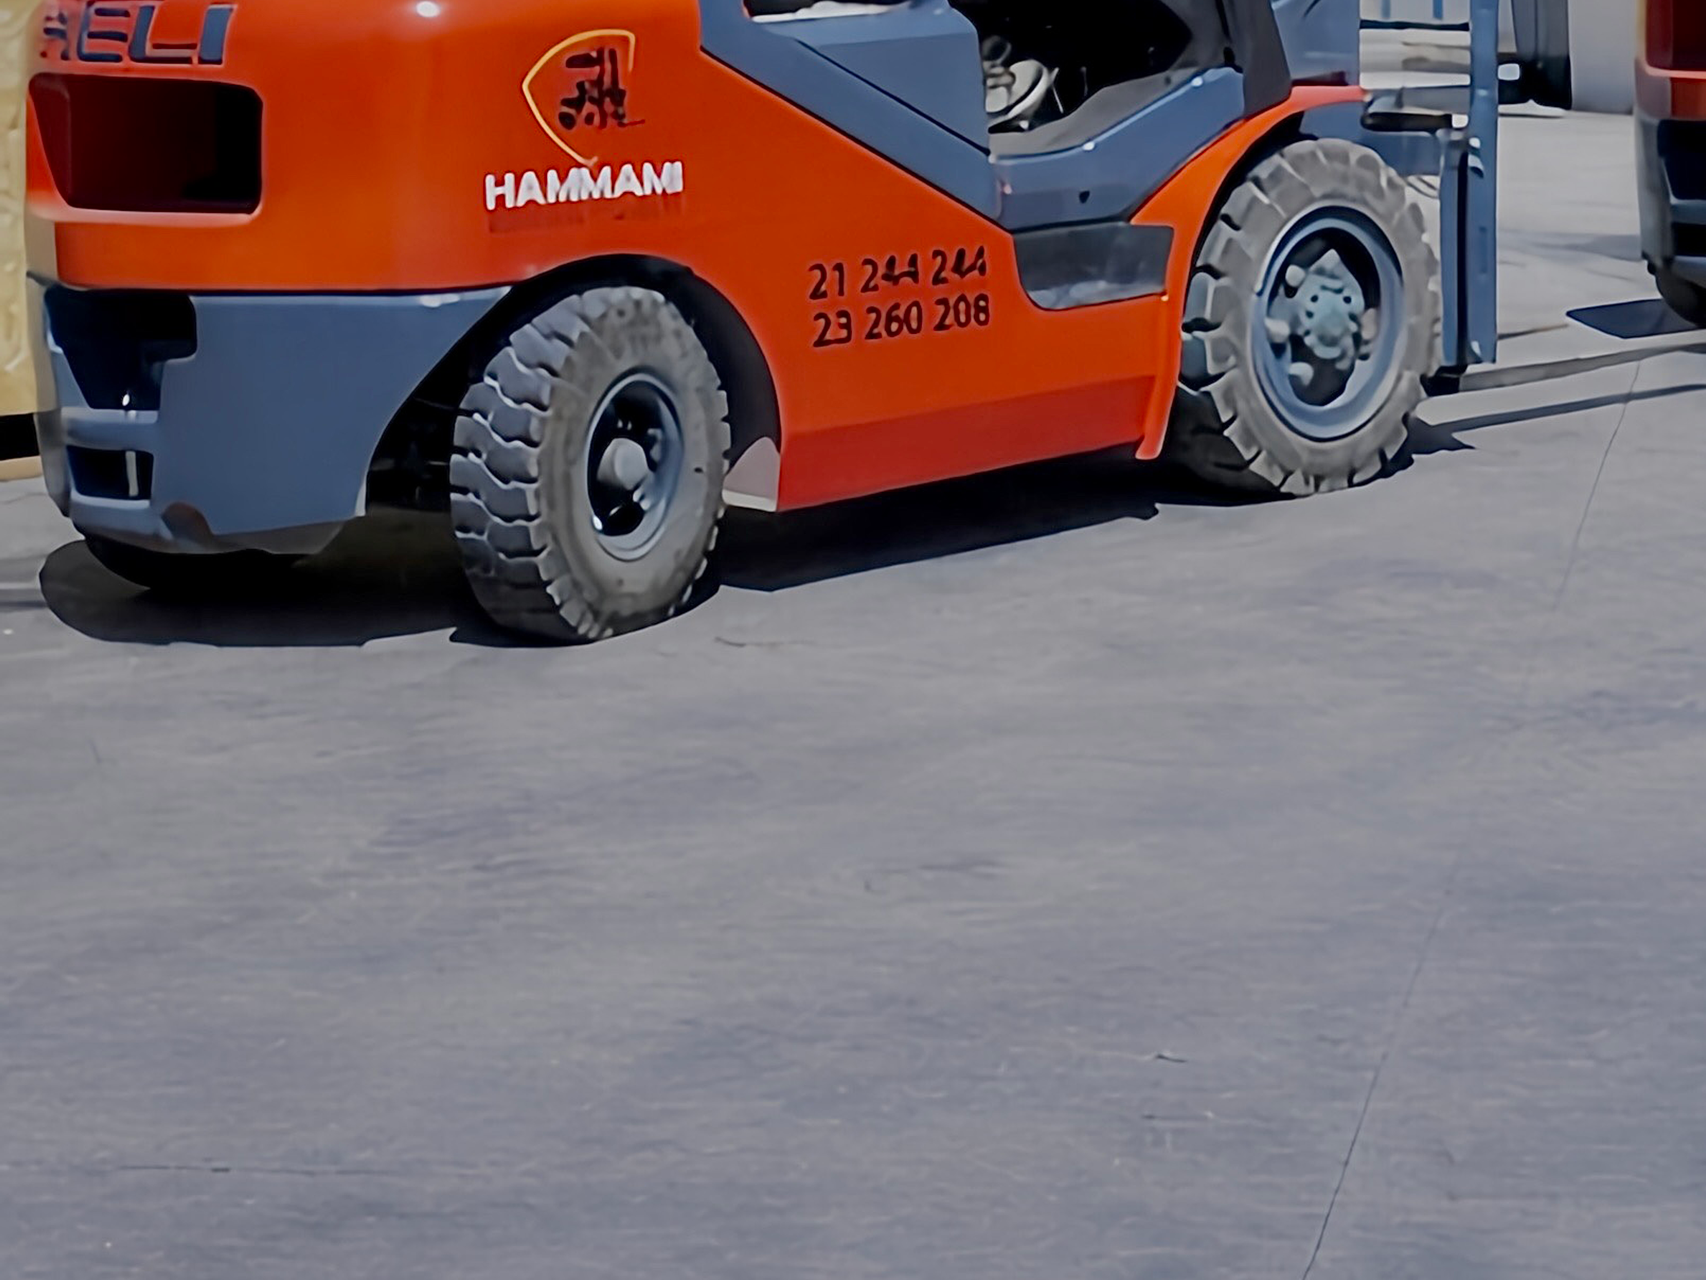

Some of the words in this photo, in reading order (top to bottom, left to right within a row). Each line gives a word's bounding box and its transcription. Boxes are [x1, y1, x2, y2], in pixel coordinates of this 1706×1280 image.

[808, 263, 845, 300] 21
[860, 253, 919, 293] 244
[931, 245, 987, 286] 244
[813, 310, 852, 347] 23
[864, 300, 922, 340] 260
[933, 293, 990, 331] 208
